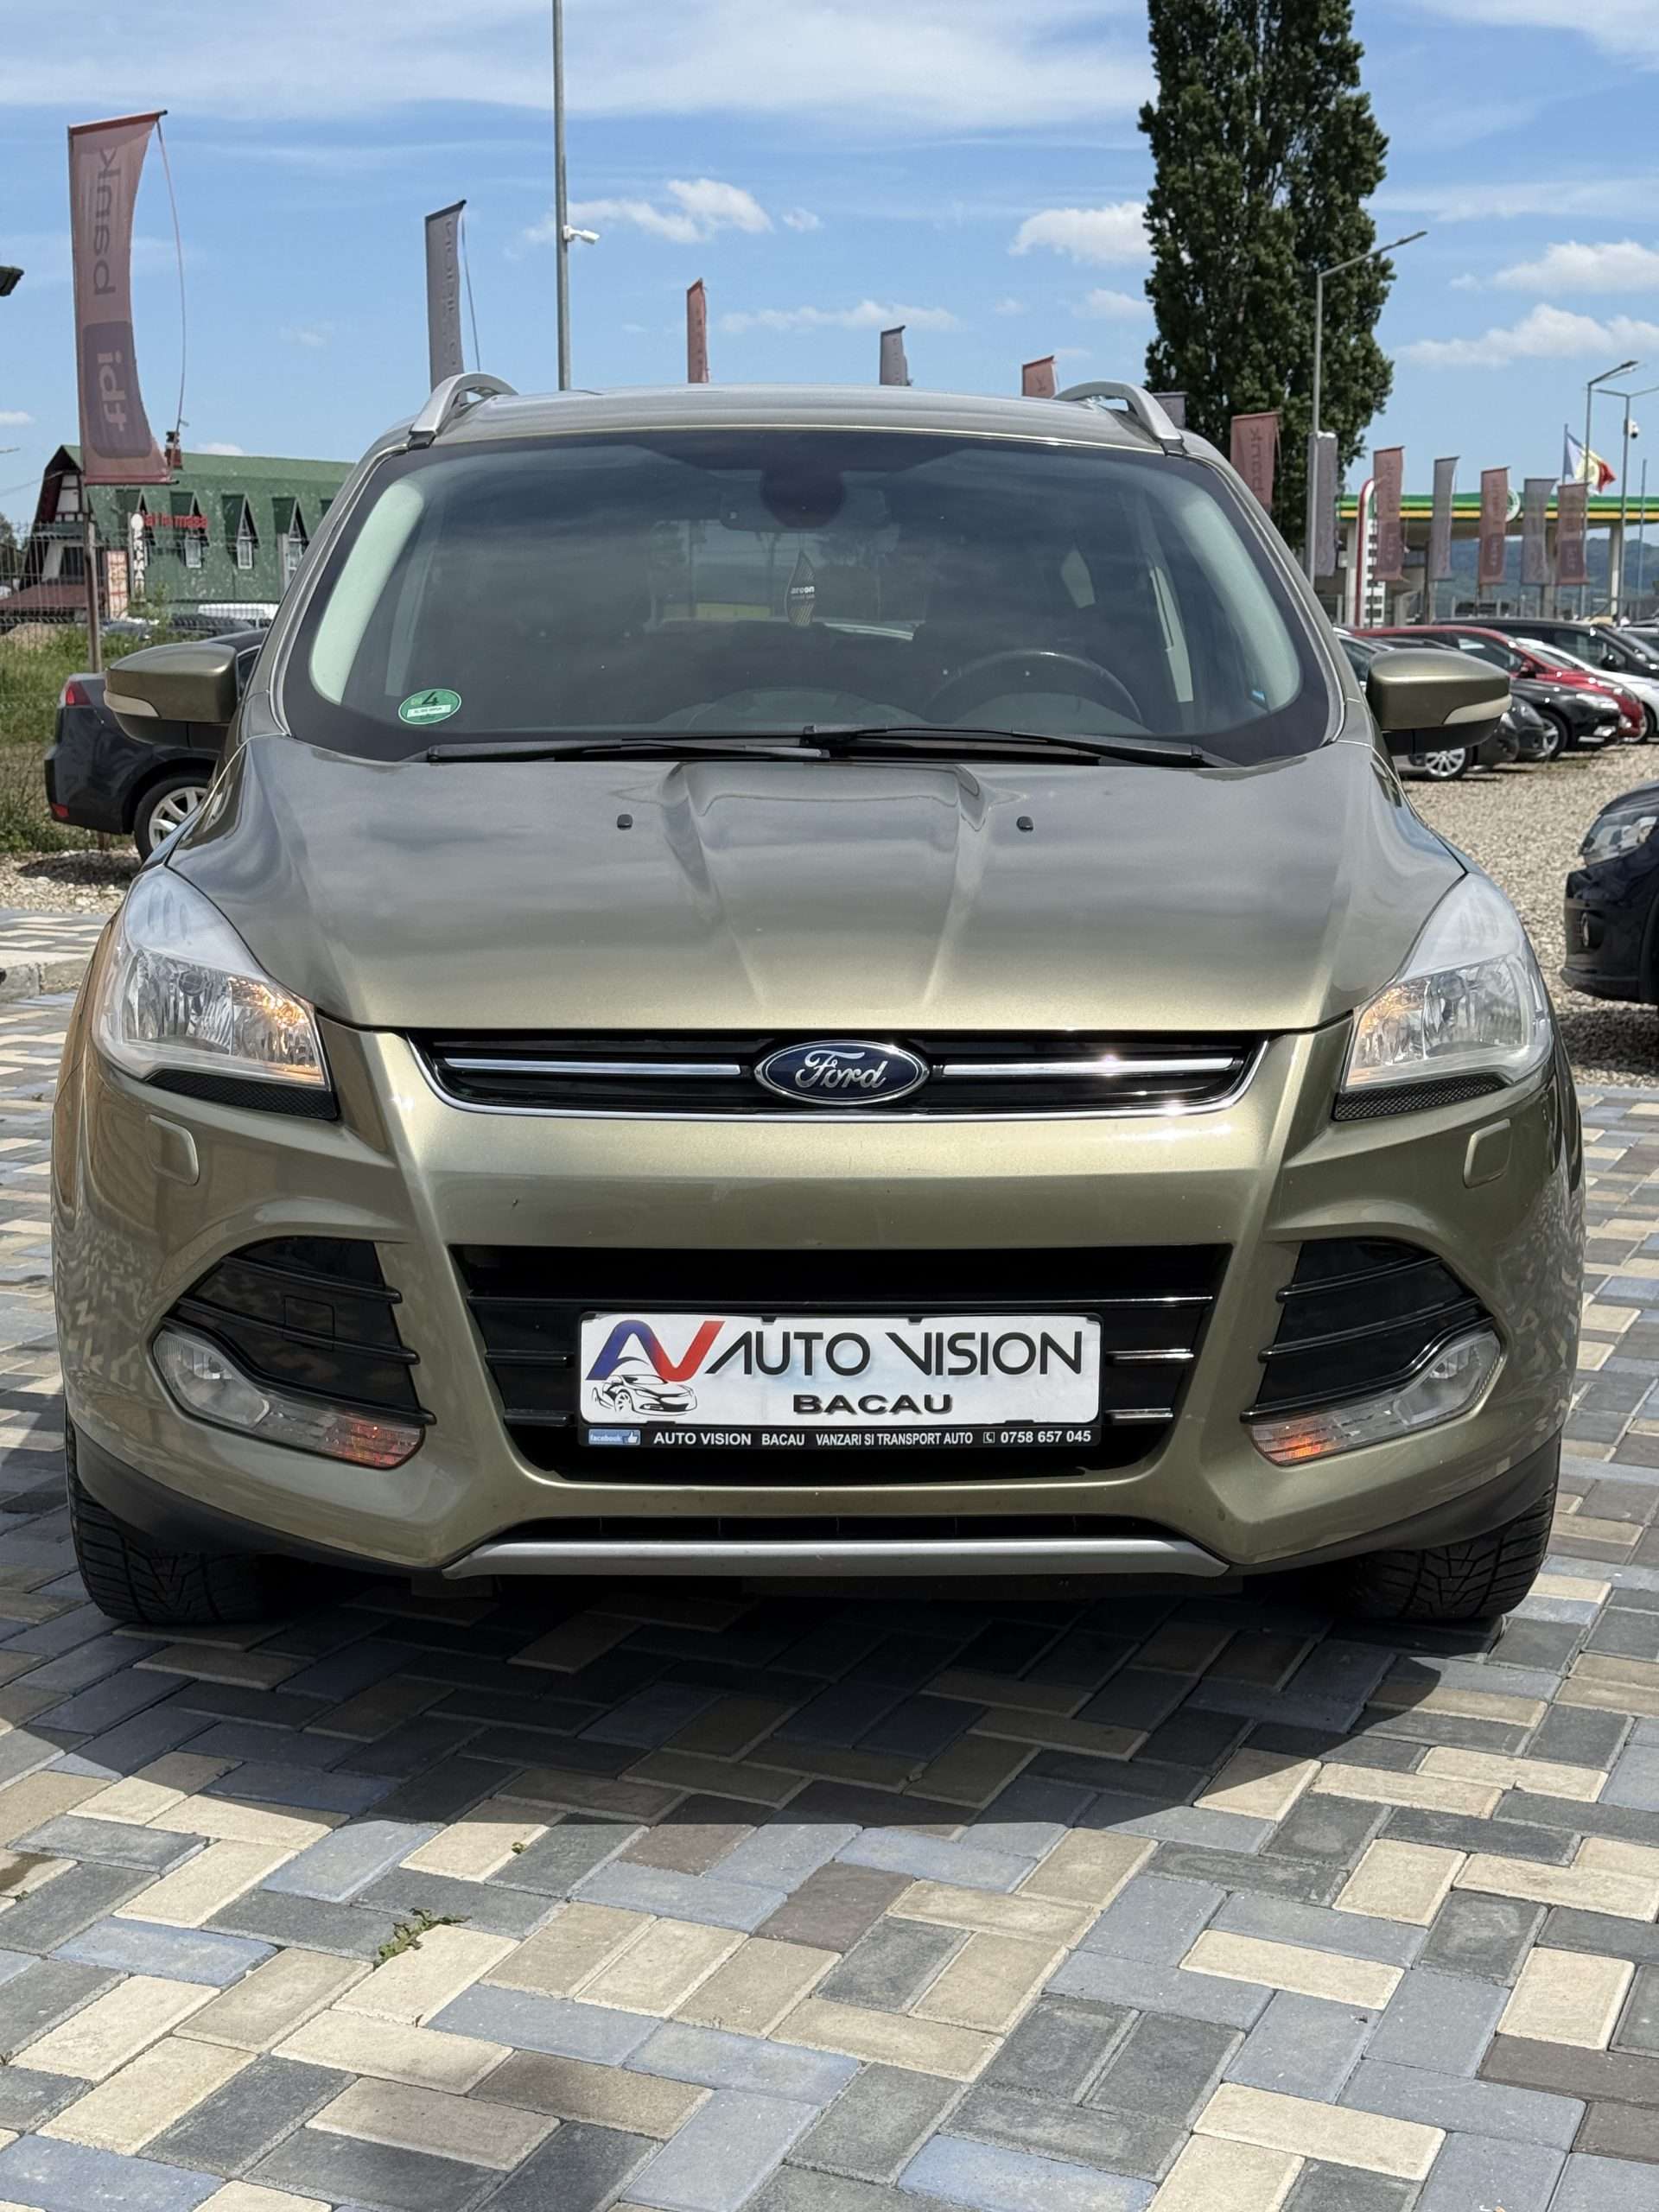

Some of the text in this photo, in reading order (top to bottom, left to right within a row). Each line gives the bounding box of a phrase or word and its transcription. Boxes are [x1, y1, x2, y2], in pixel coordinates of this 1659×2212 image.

[422, 690, 439, 706] 4
[795, 1050, 888, 1089] Ford
[704, 1331, 1083, 1376] AUTO VISION
[793, 1394, 953, 1414] BACAU
[653, 1430, 1091, 1446] AUTO VISION BACAU VANZARI SI TRANSPORT AUTO 0758 657 045
